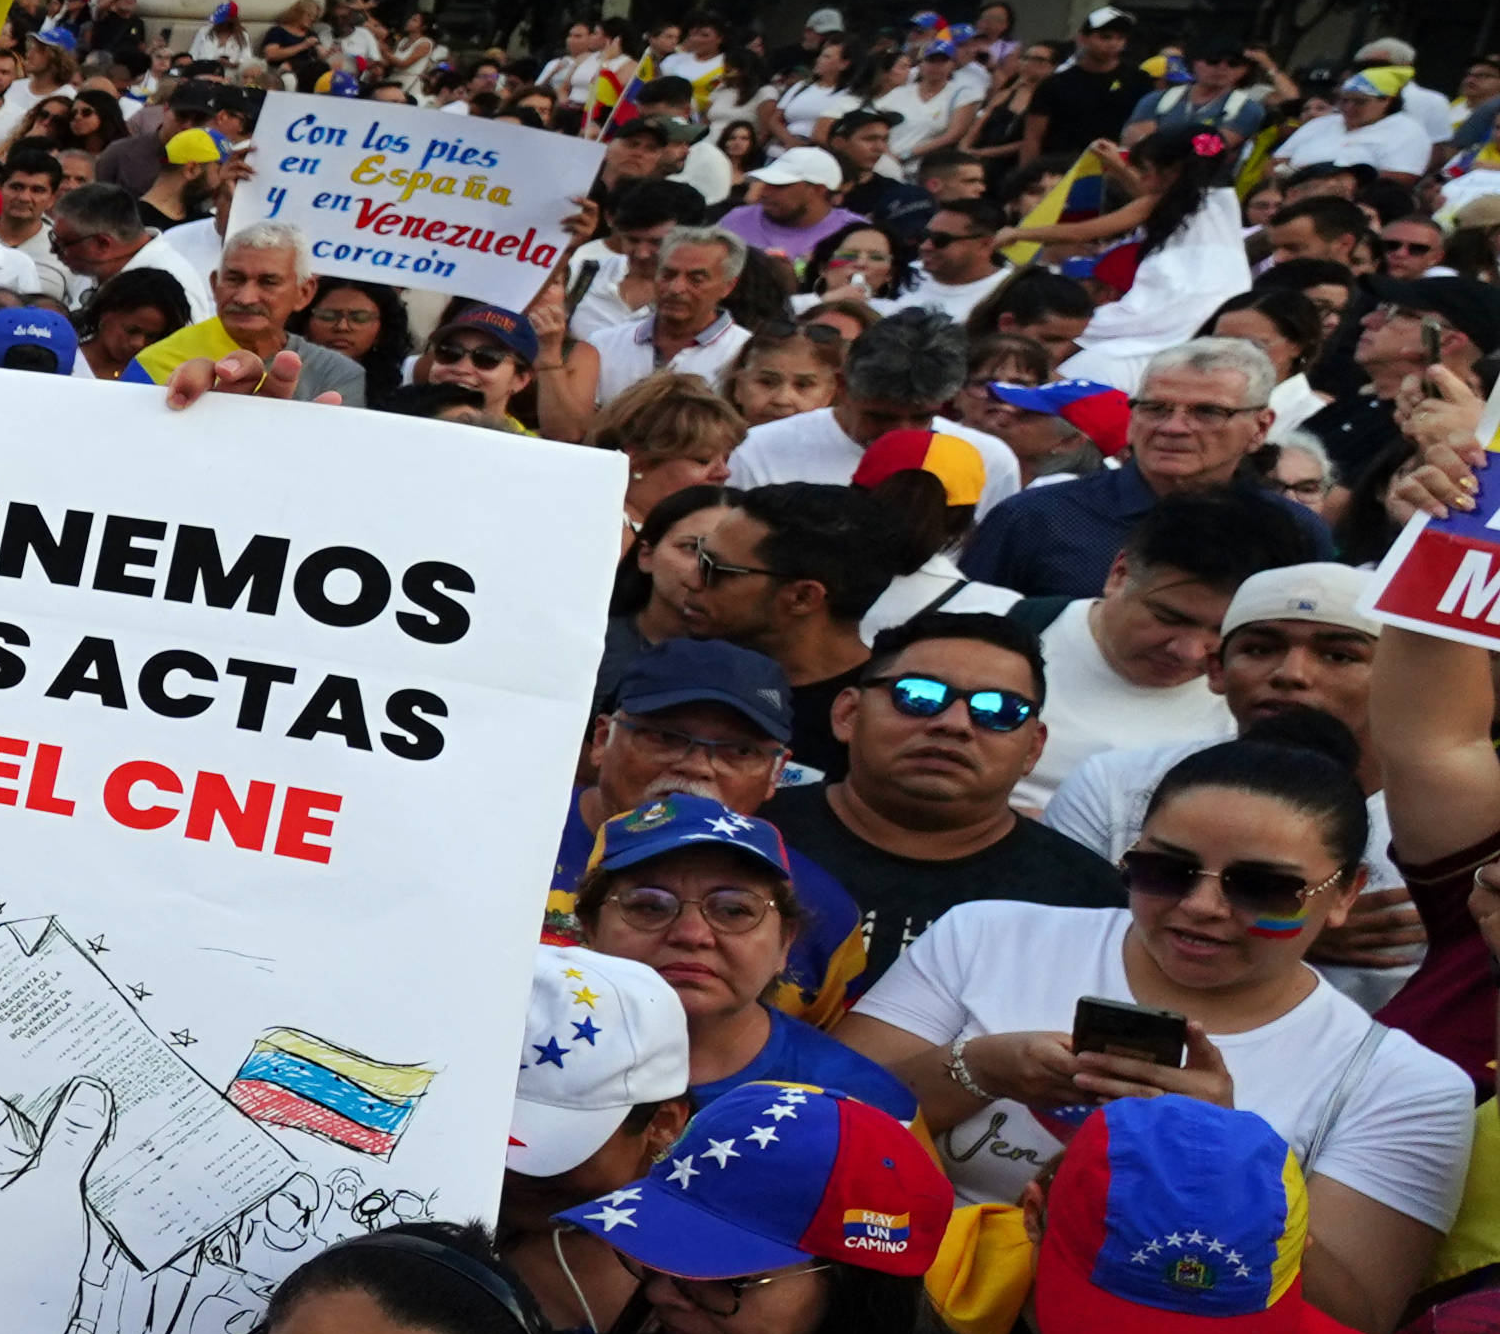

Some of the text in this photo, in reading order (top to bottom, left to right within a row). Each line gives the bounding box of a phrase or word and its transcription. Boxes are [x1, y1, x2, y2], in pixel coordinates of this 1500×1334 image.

[285, 113, 501, 171] Con los pies
[279, 154, 513, 208] en España
[266, 186, 558, 269] y en Venezuela
[312, 239, 457, 279] corazón
[46, 637, 449, 762] ACTAS
[102, 760, 343, 866] CNE
[38, 979, 50, 992] DE
[50, 969, 63, 981] LA
[8, 987, 73, 1041] BOLIVARIANA DE
[11, 987, 57, 1026] REPUBLICA
[24, 1000, 72, 1040] VENEZUELA
[861, 1210, 895, 1228] HAY
[866, 1224, 891, 1241] UN
[844, 1236, 909, 1254] CAMINO
